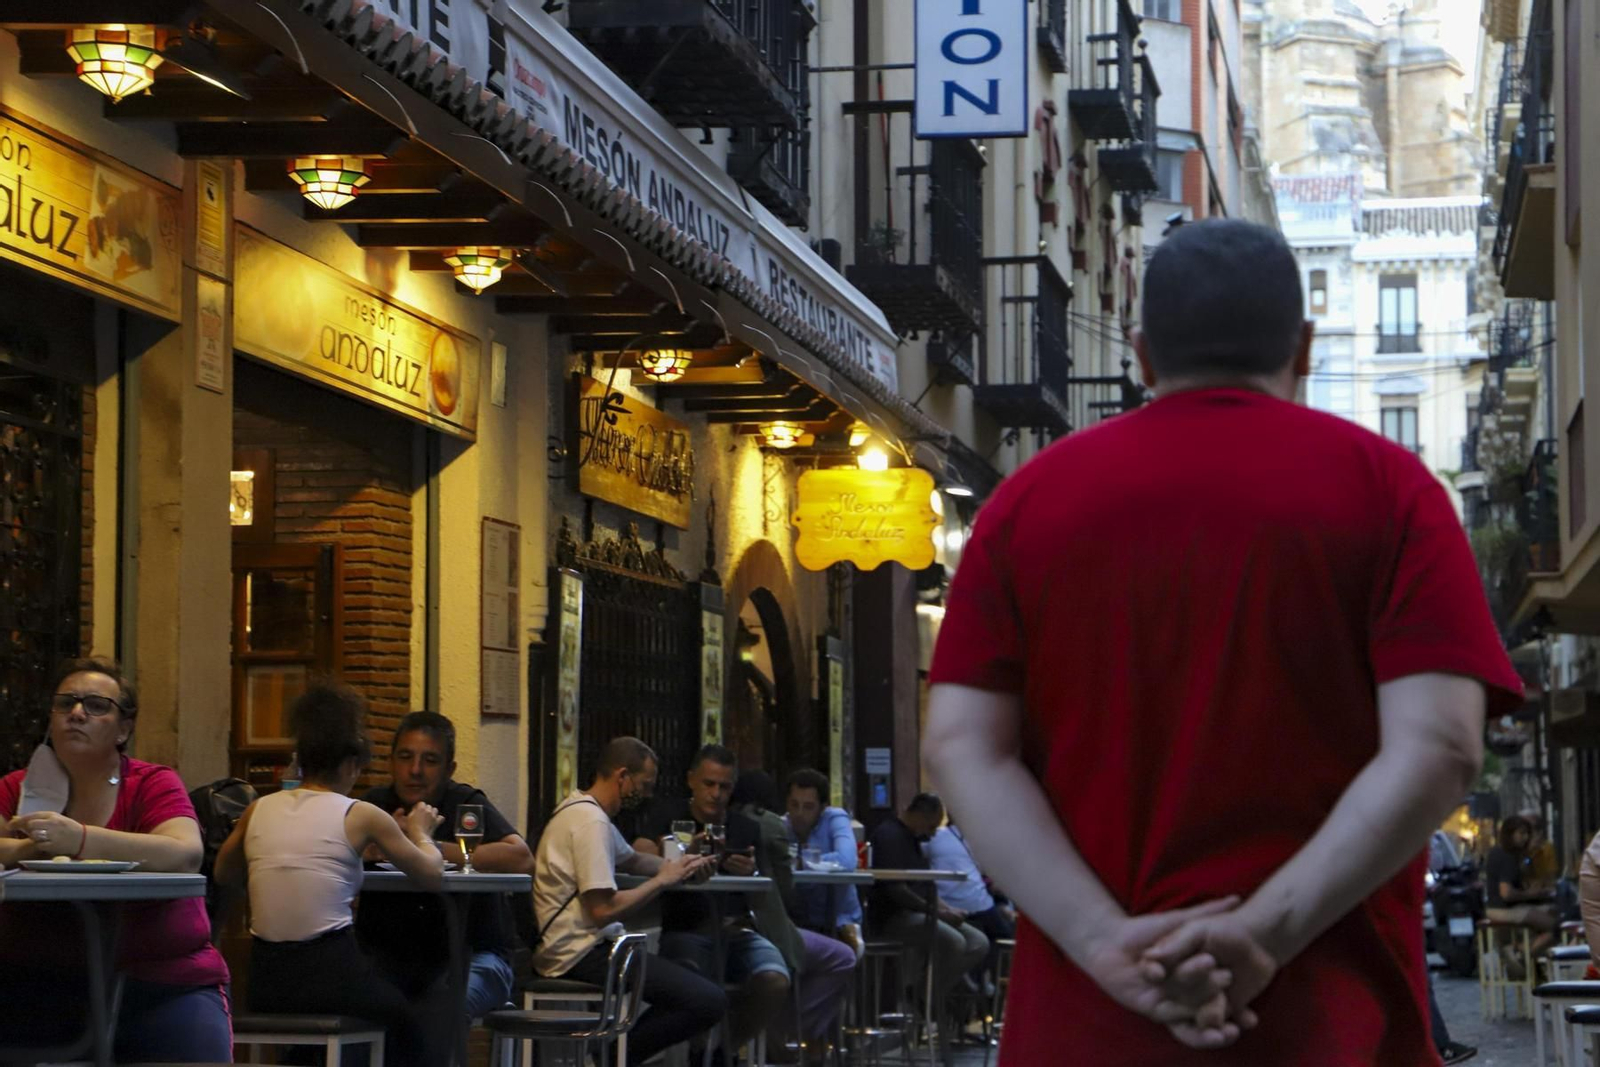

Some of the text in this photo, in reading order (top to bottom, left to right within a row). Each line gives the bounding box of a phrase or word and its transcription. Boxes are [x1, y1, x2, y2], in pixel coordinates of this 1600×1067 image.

[563, 94, 875, 374] MESÓN ANDALUZ RESTAURANTE
[320, 324, 422, 398] andaluz
